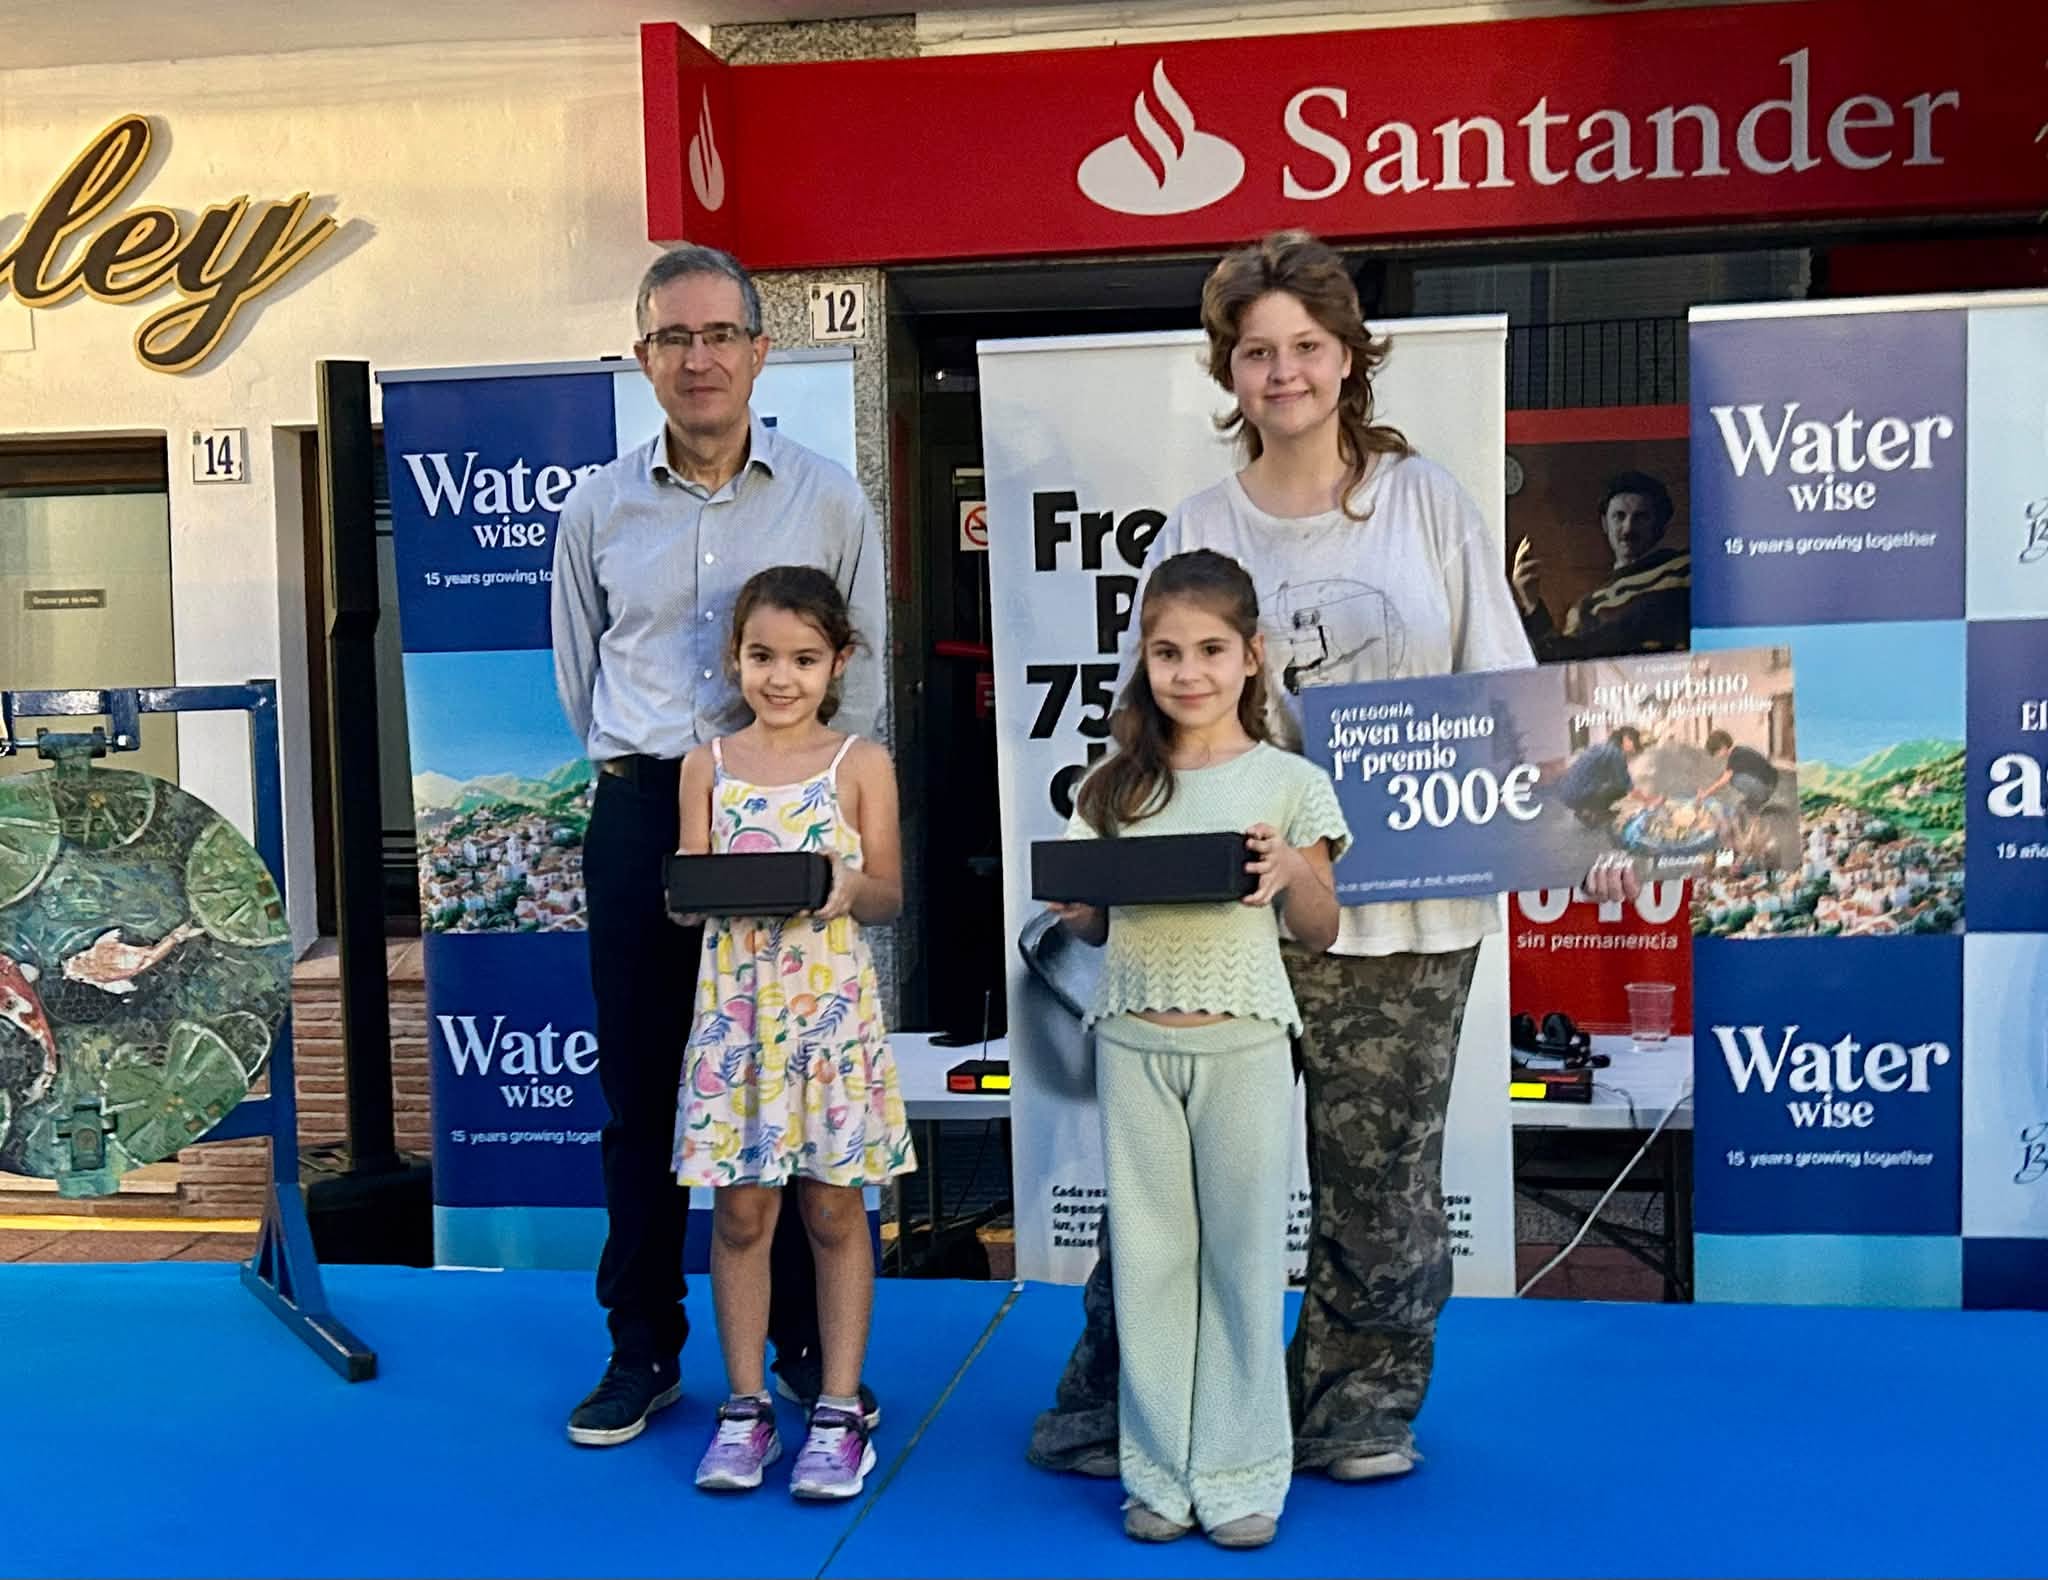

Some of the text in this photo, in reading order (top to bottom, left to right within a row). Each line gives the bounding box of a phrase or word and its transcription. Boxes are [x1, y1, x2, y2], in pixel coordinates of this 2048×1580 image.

[1282, 48, 1960, 200] Santander
[0, 113, 339, 374] ley
[825, 289, 857, 333] 12
[204, 435, 234, 475] 14
[1710, 402, 1954, 477] Water
[1787, 473, 1876, 512] wise
[472, 515, 546, 549] wise
[1033, 491, 1167, 571] Fre
[1725, 530, 1937, 557] 15 years growing together
[424, 571, 441, 586] 15
[444, 572, 481, 588] years
[482, 568, 537, 587] growing
[1026, 663, 1121, 739] 75
[1328, 712, 1495, 749] Joven talento
[1362, 743, 1457, 782] premio
[1387, 764, 1543, 831] 300€
[1987, 753, 2048, 817] a
[1516, 930, 1679, 951] sin permanencia
[436, 1015, 599, 1076] Wate
[1710, 1025, 1951, 1093] Water
[500, 1077, 574, 1108] wise
[1787, 1092, 1874, 1128] wise
[450, 1130, 467, 1143] 15
[470, 1131, 508, 1145] years
[510, 1130, 564, 1145] growing
[1726, 1150, 1934, 1169] 15 years growing together
